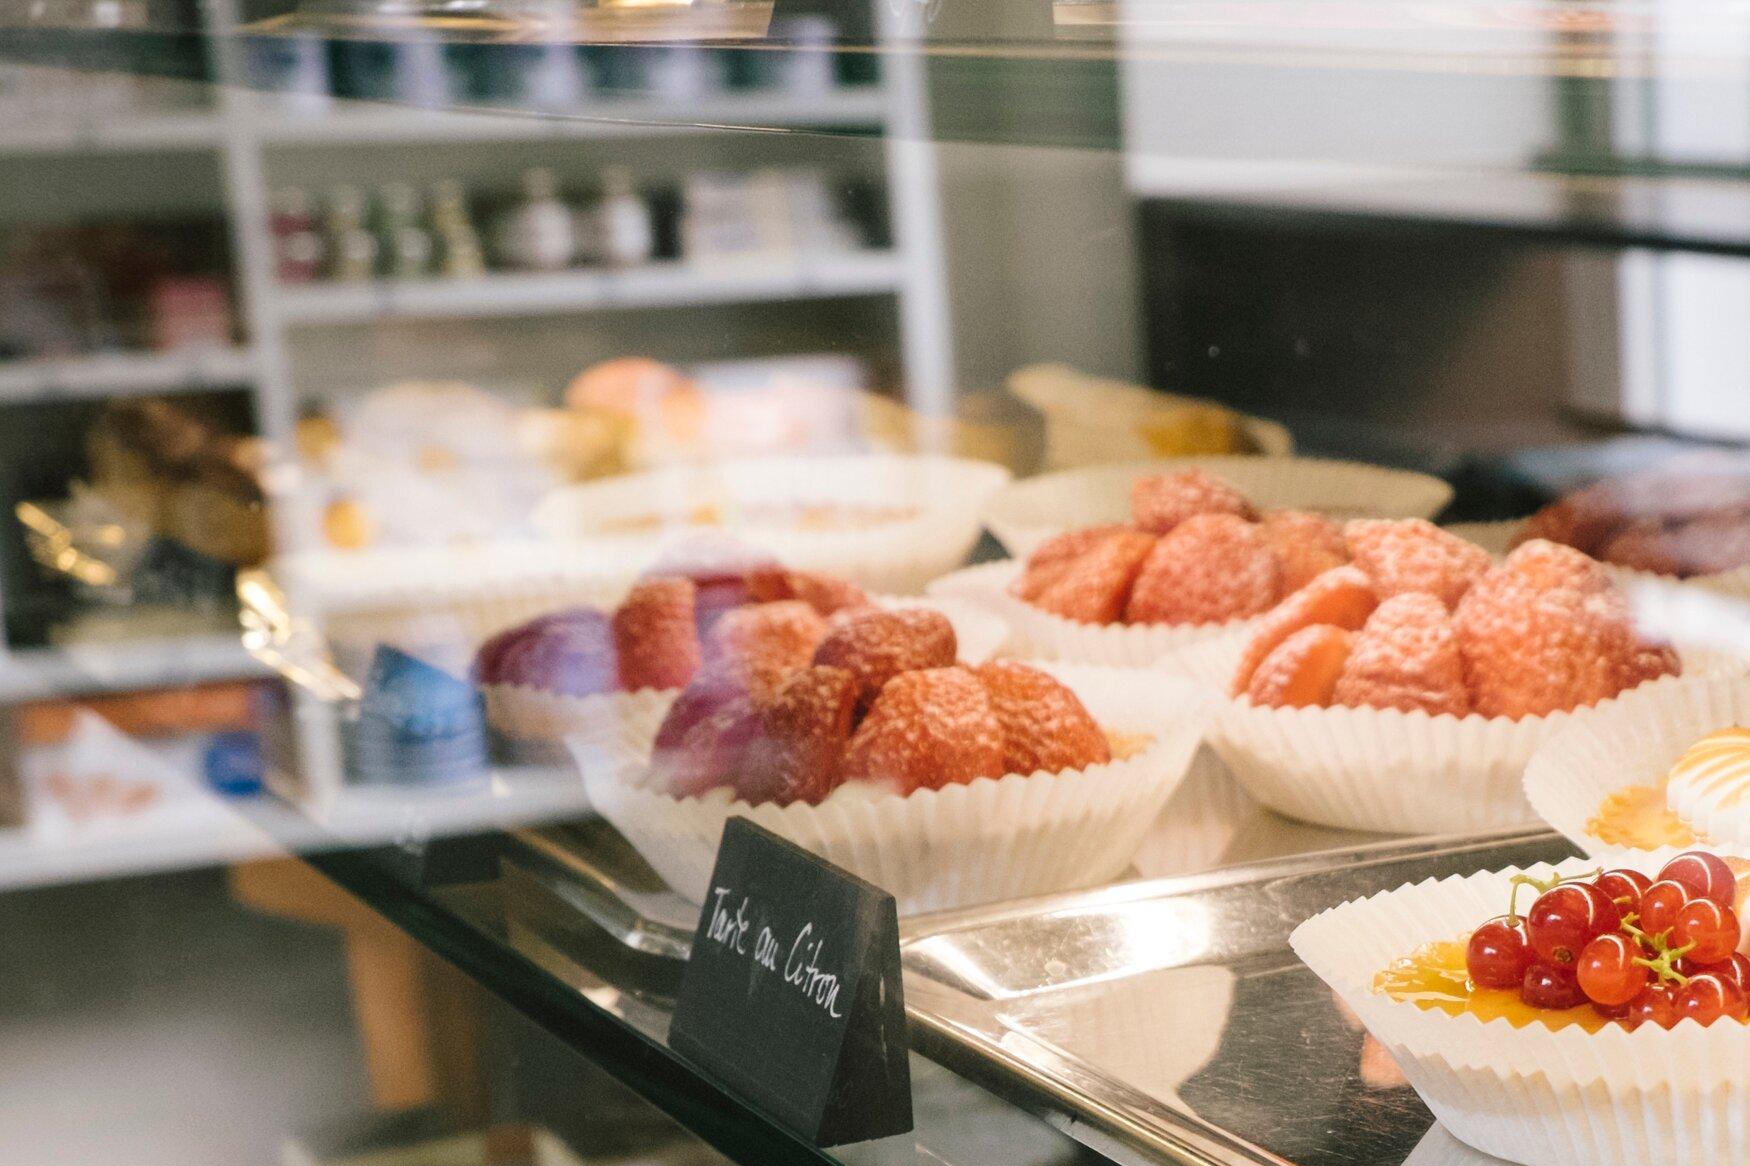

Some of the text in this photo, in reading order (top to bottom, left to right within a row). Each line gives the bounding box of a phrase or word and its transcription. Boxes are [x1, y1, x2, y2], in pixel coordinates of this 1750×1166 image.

[707, 887, 842, 1018] Tarte au Citron
